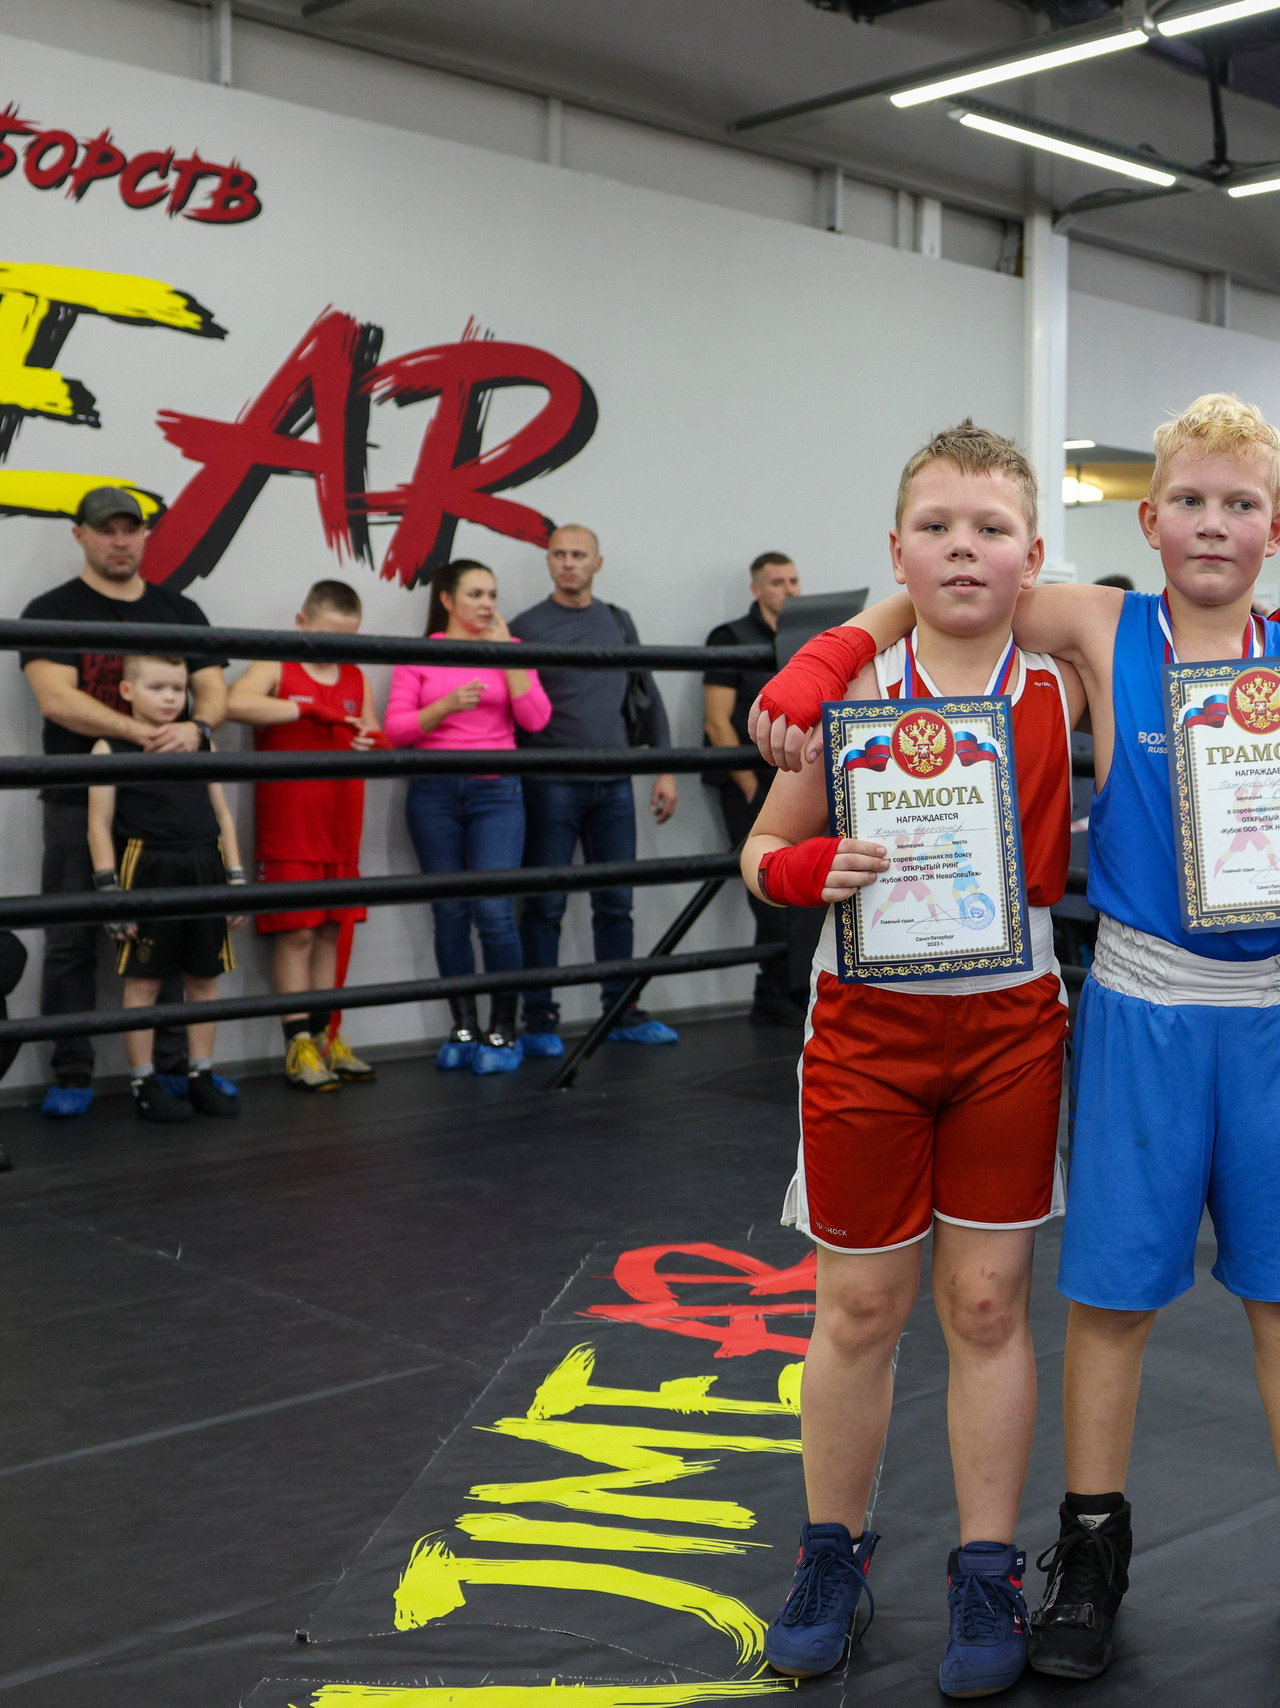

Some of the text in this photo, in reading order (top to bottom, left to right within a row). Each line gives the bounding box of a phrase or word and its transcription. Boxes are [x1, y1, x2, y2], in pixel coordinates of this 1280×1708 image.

[1137, 731, 1168, 746] BOX
[866, 786, 984, 811] ГРАМОТА
[896, 813, 959, 824] НАГРАЖДАЕТСЯ
[1241, 813, 1280, 823] ОТКРЫТЫЙ
[892, 854, 944, 864] соревнованиях
[954, 851, 972, 859] боксу
[902, 861, 960, 872] ОТКРЫТЫЙ РИНГ
[915, 934, 955, 942] Санкт-Петербург
